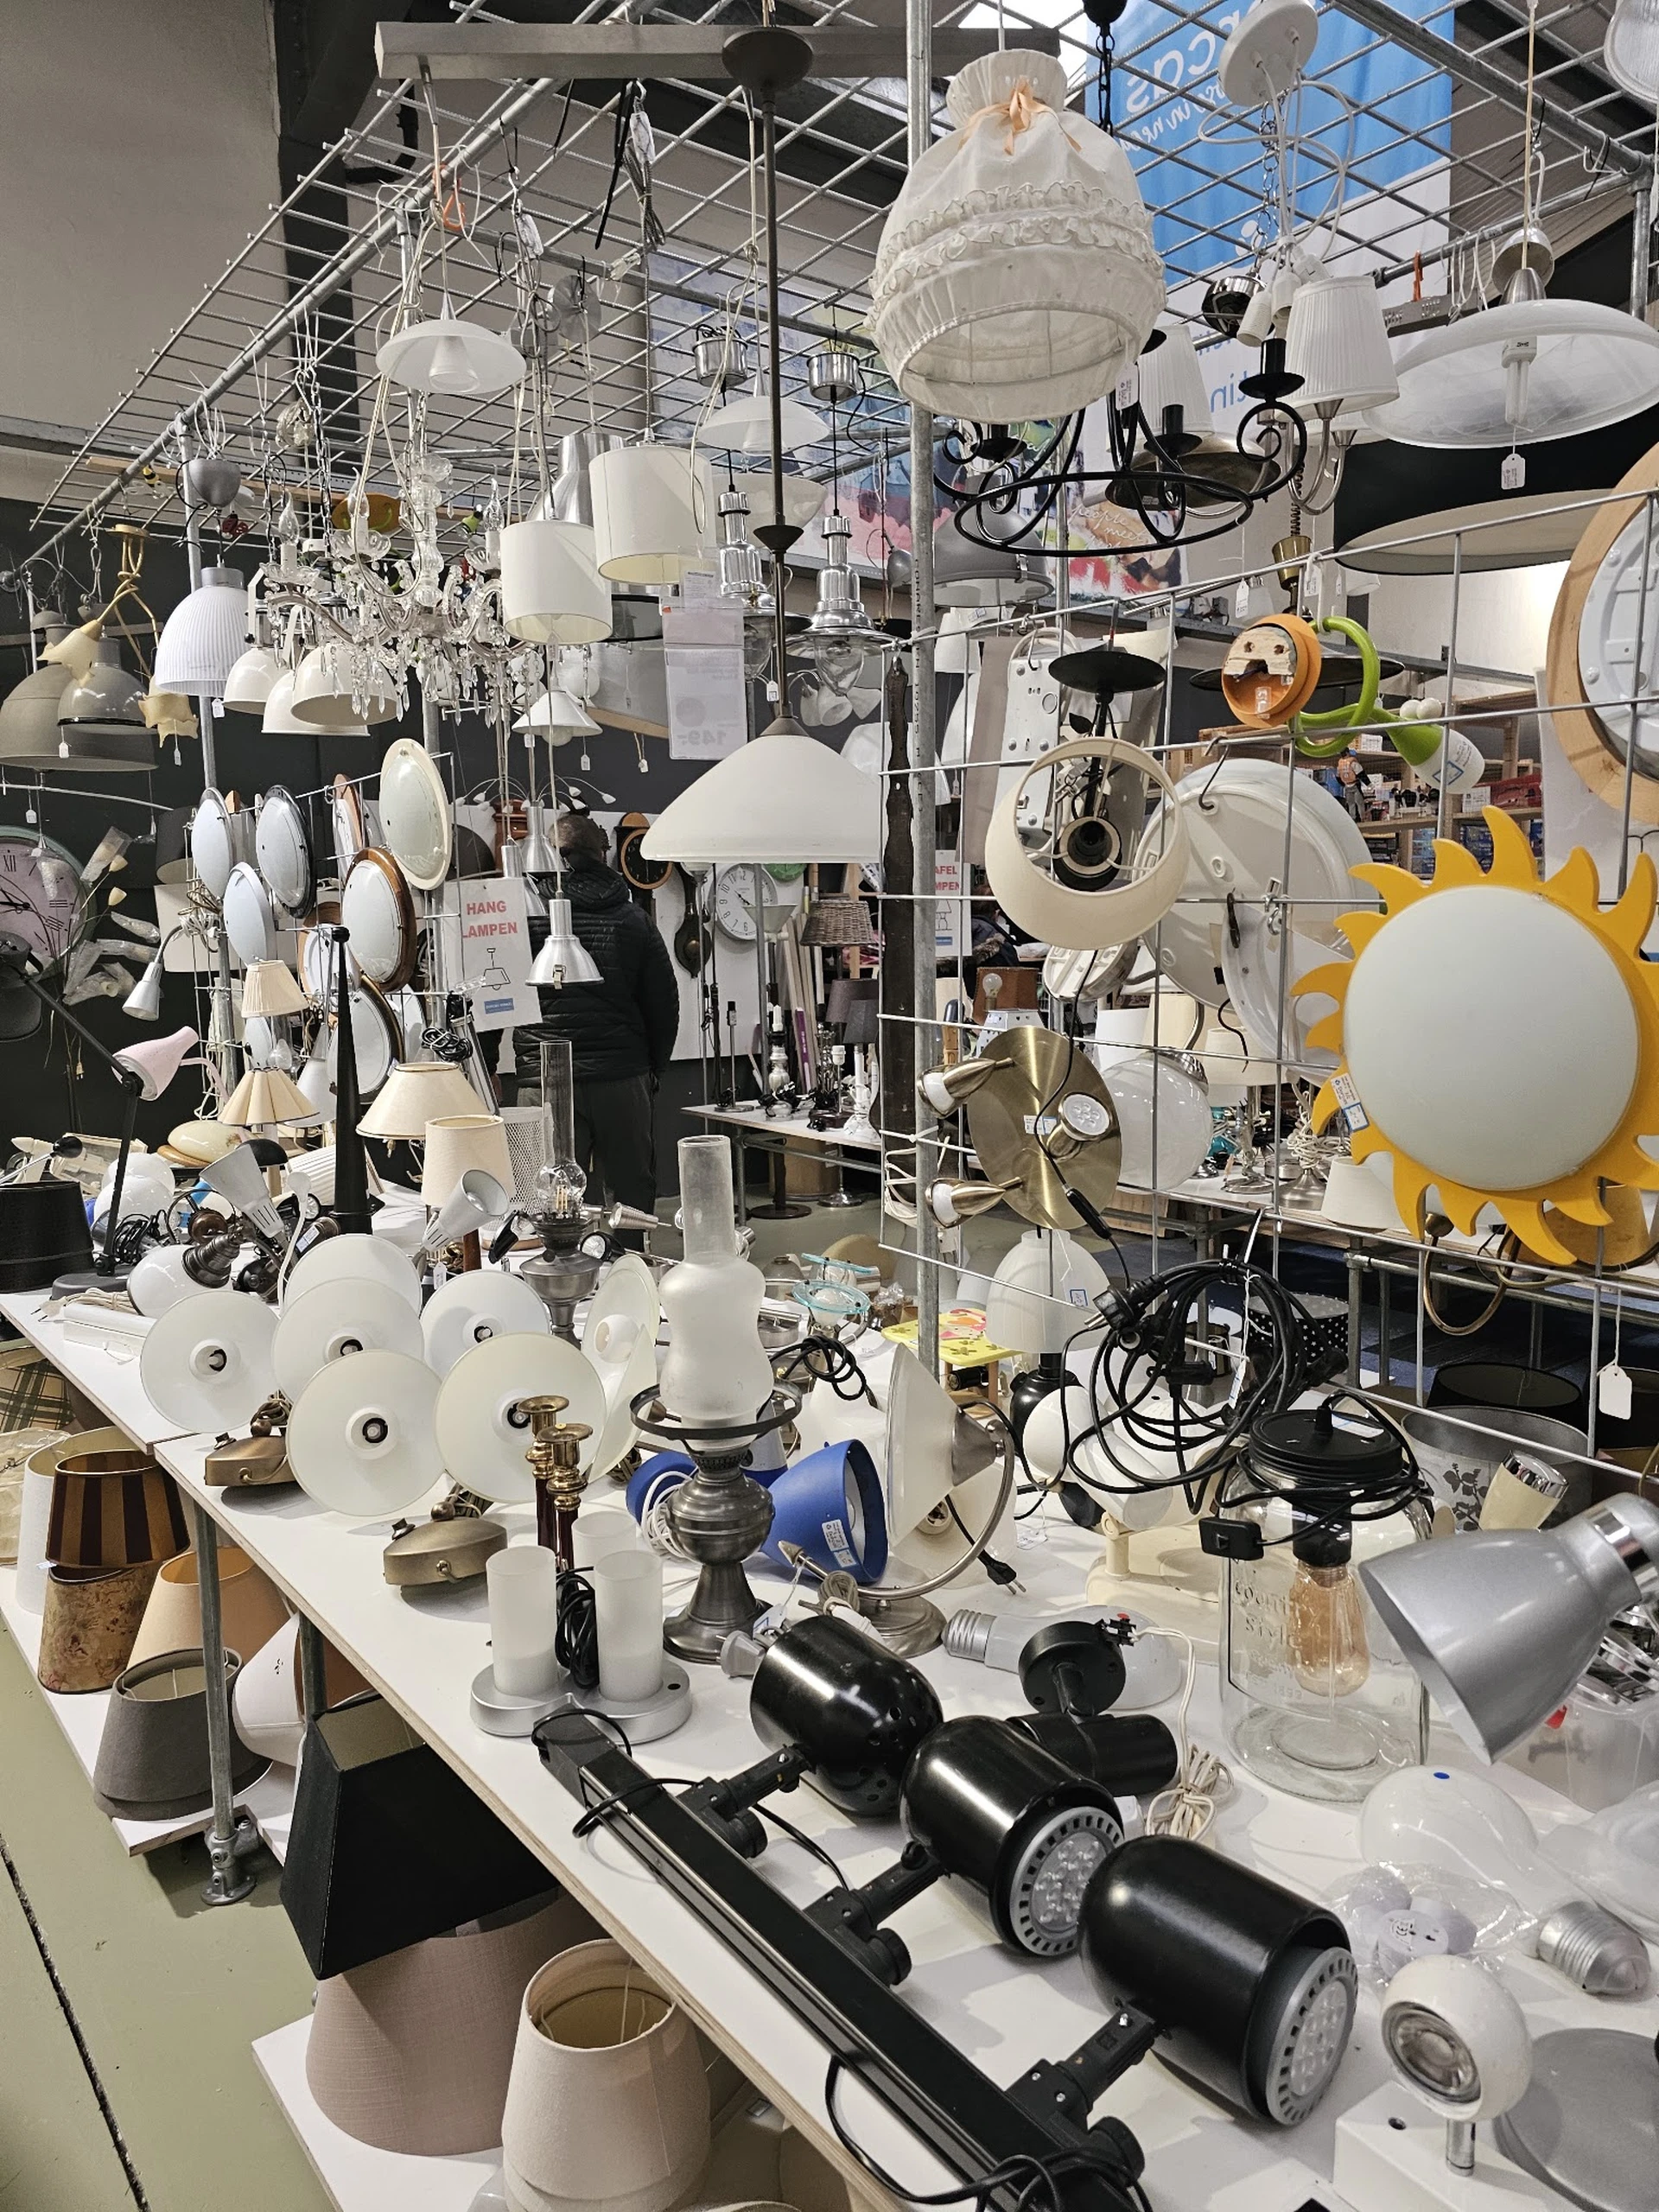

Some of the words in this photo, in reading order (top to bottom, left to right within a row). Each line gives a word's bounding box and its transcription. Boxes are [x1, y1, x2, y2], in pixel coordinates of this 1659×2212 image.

[934, 866, 957, 874] AFEL
[934, 881, 960, 891] MPEN
[467, 900, 507, 916] HANG
